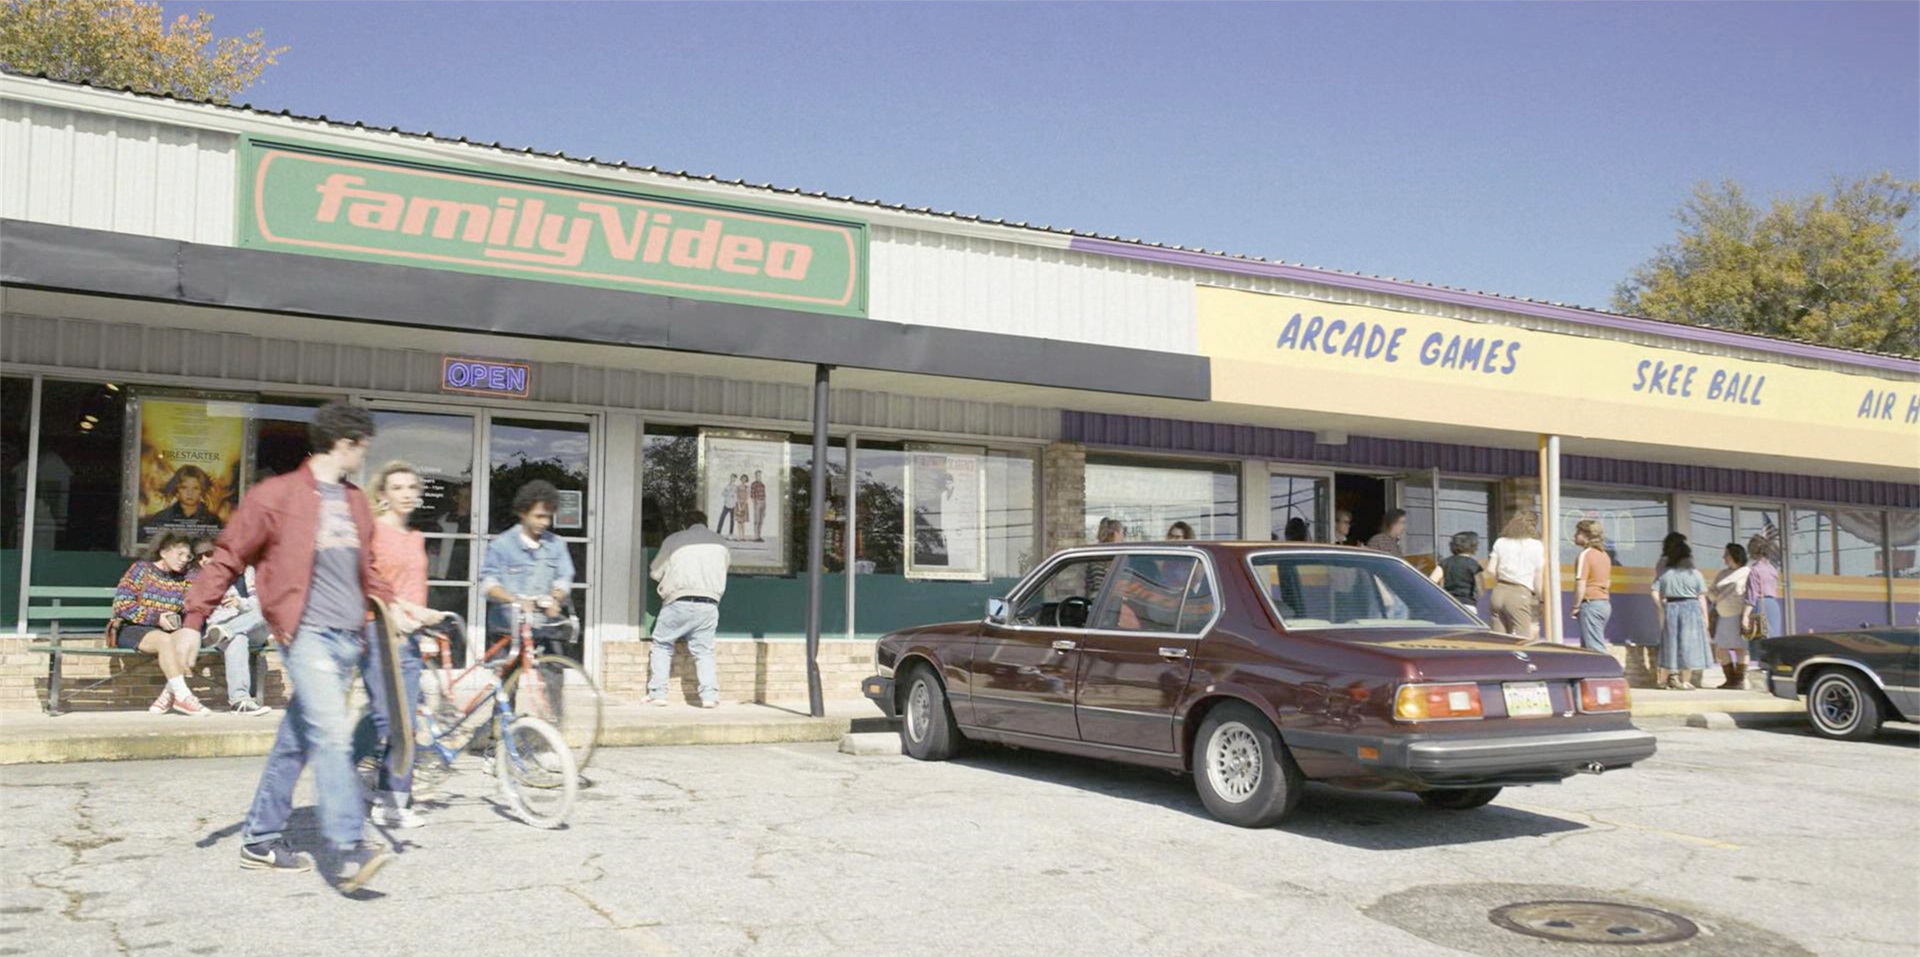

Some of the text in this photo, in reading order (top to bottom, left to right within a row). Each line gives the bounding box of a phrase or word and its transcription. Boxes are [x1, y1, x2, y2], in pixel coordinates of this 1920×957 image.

[1277, 313, 1521, 375] ARCADE GAMES
[448, 362, 525, 391] OPEN
[1633, 359, 1766, 405] SKEE BALL
[1857, 389, 1897, 420] AIR
[162, 449, 221, 461] FIRESTARTER
